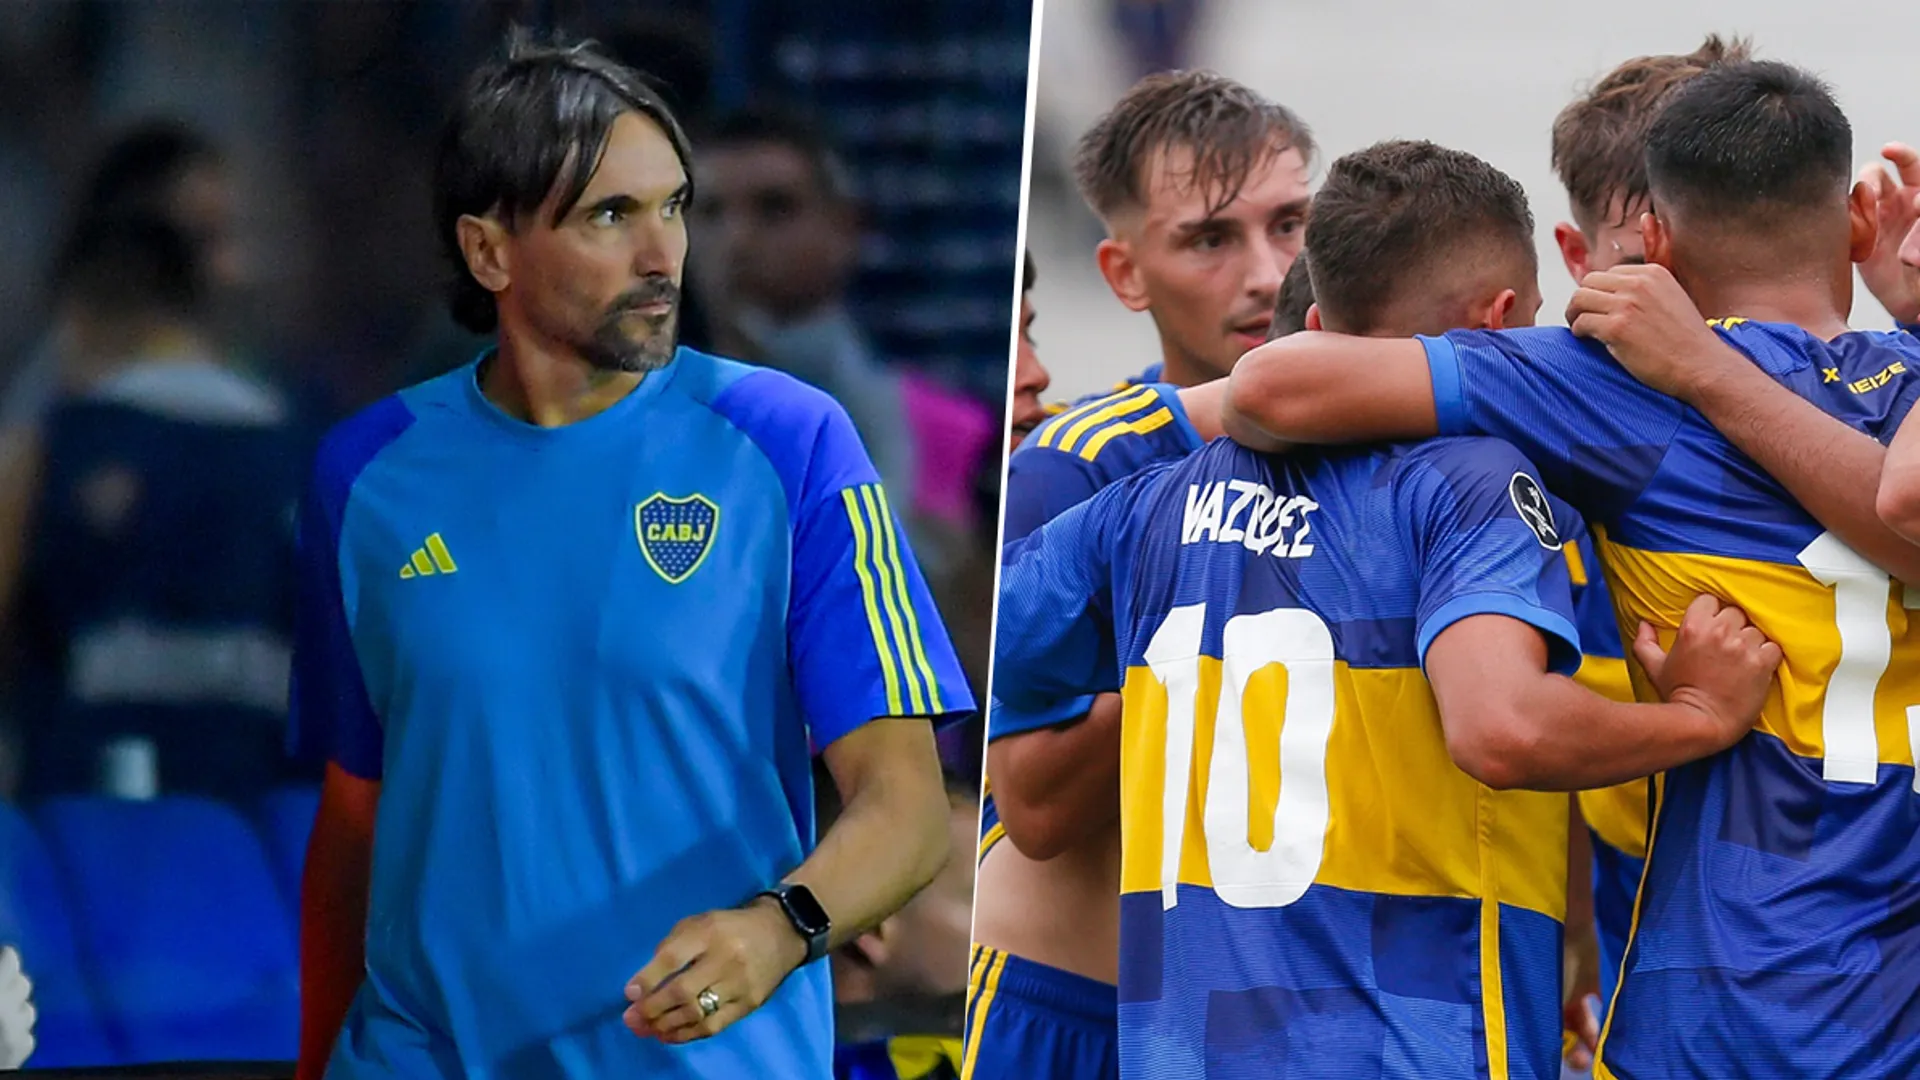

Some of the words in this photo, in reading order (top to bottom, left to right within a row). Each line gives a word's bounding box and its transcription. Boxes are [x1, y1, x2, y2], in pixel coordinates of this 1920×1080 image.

[647, 523, 706, 541] CABJ
[1181, 479, 1319, 558] VAZQUEZ
[1796, 530, 1920, 794] 1
[1143, 602, 1335, 911] 10
